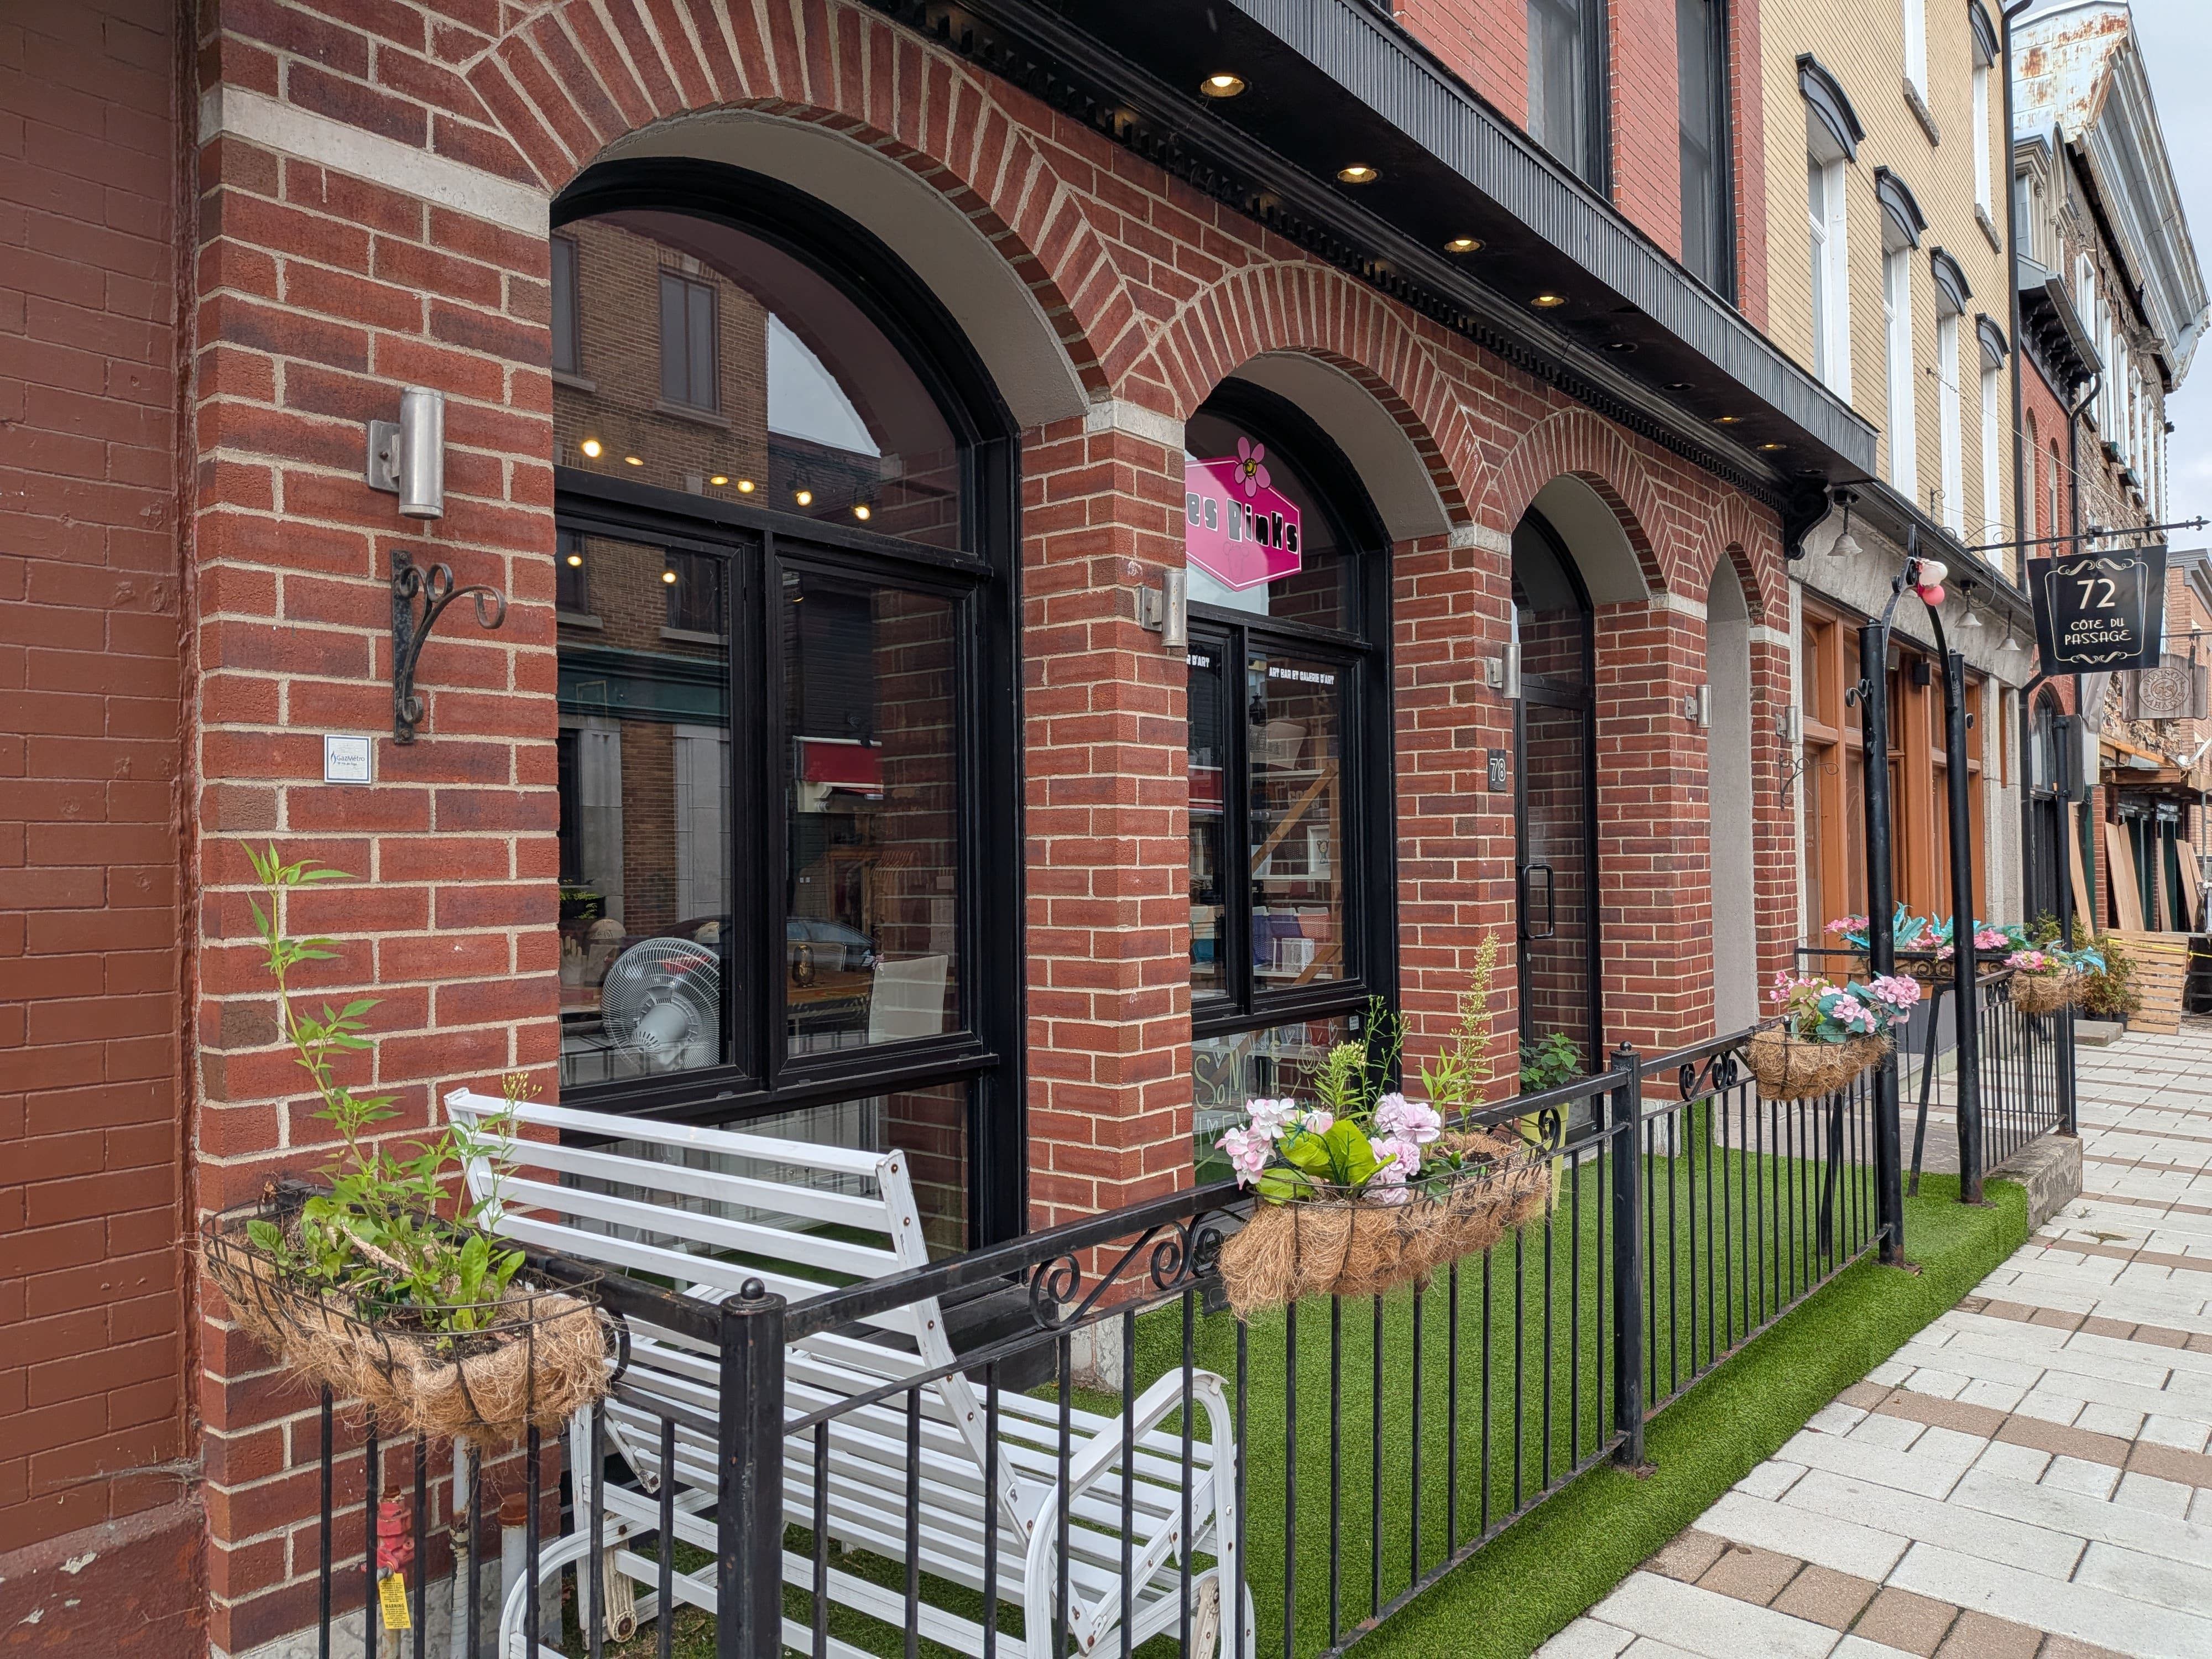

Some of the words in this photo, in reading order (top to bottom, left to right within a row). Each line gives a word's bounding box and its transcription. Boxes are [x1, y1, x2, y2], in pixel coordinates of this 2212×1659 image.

[2077, 578, 2115, 609] 72
[2070, 619, 2104, 630] CÔTE
[2110, 618, 2125, 627] DU
[2064, 630, 2132, 645] PASSAGE
[1269, 666, 1280, 677] ART
[1280, 668, 1291, 679] BAR
[1292, 670, 1299, 680] ET
[1300, 671, 1319, 683] GALERIE
[1320, 674, 1334, 685] D'ART
[2143, 670, 2186, 685] MAISON
[1490, 758, 1506, 781] 78
